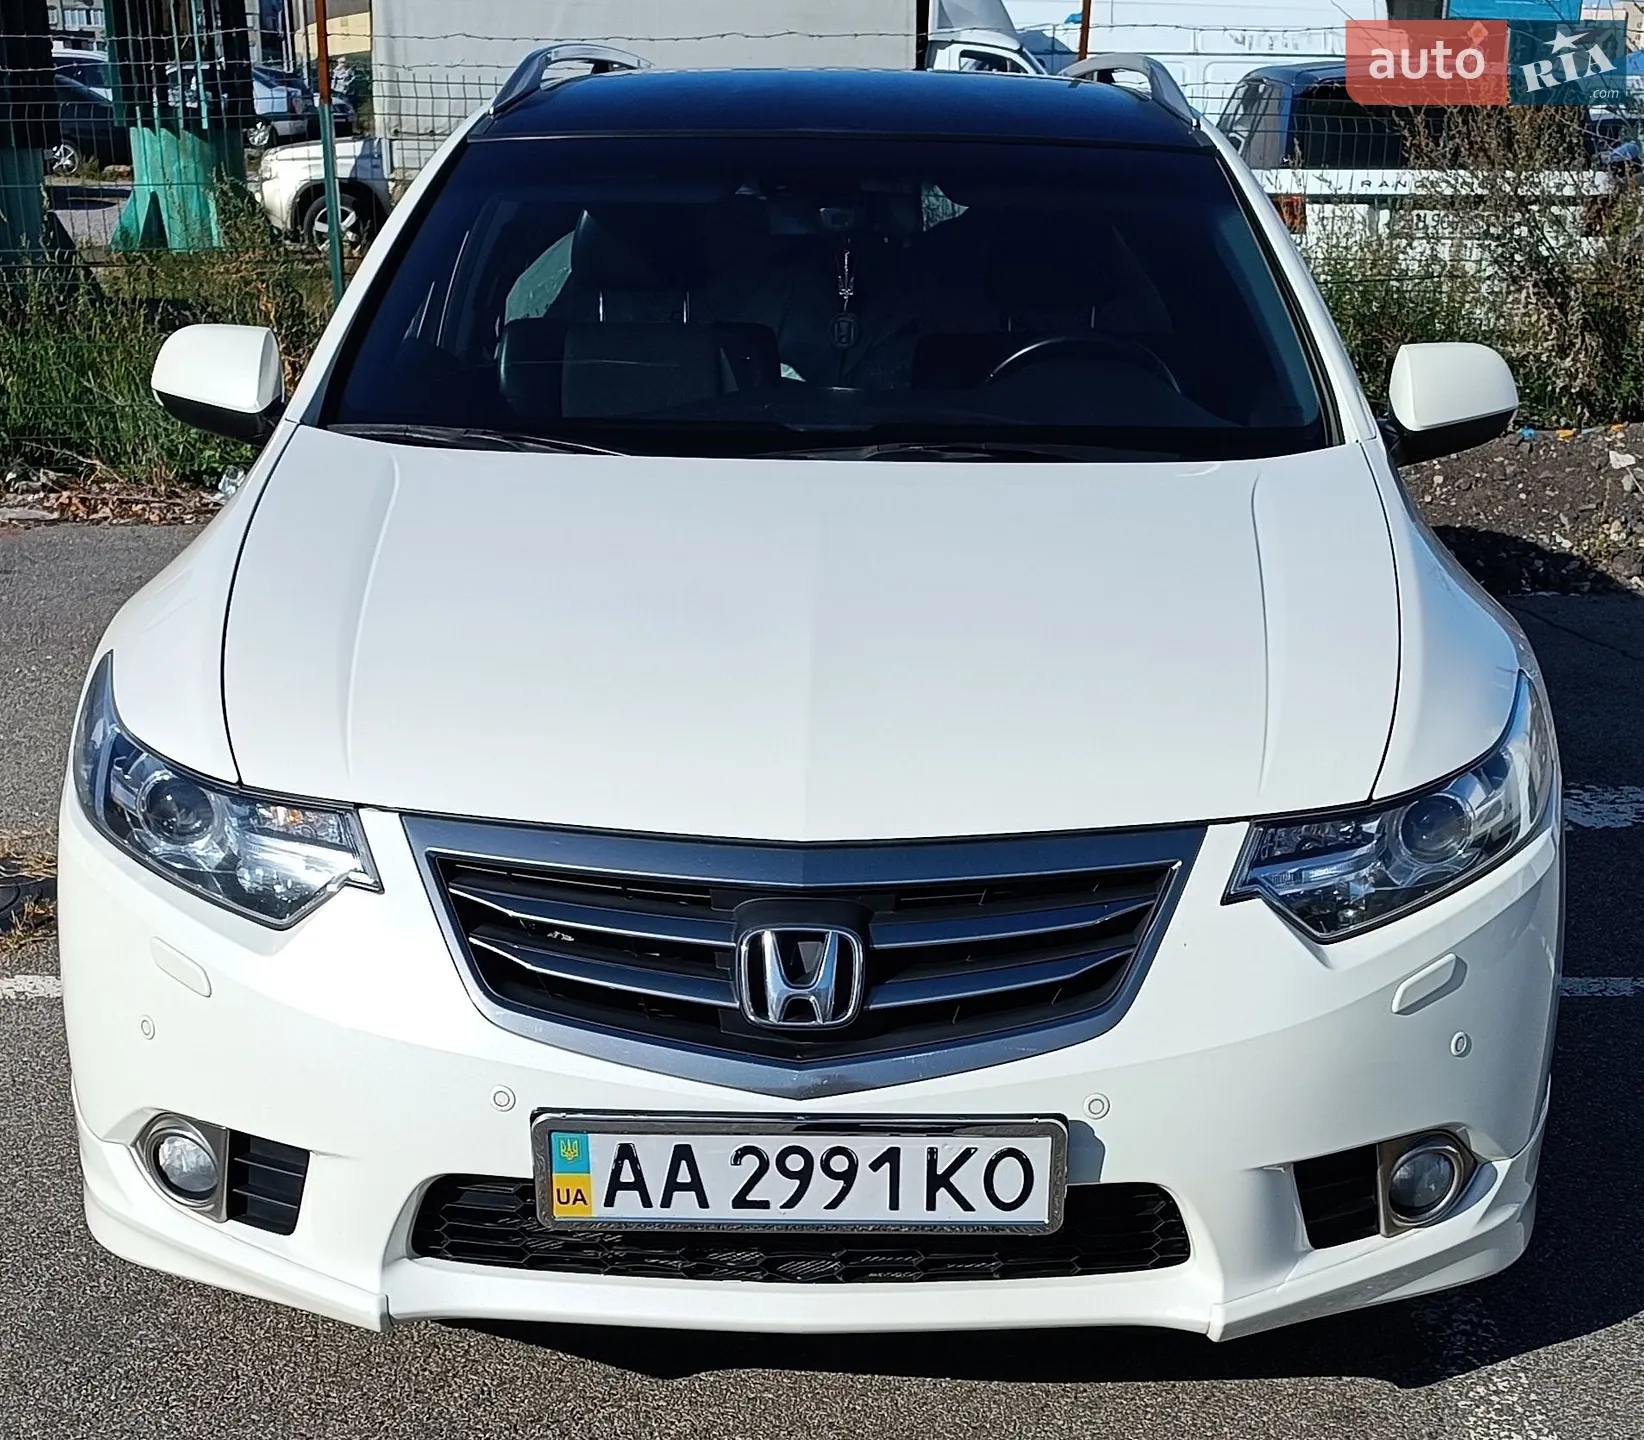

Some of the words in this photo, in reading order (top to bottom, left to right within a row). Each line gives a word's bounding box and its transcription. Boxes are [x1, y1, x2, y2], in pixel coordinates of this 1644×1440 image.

[556, 1188, 588, 1205] UA
[603, 1143, 709, 1210] AA
[730, 1144, 901, 1211] 2991
[926, 1146, 1034, 1212] KO
